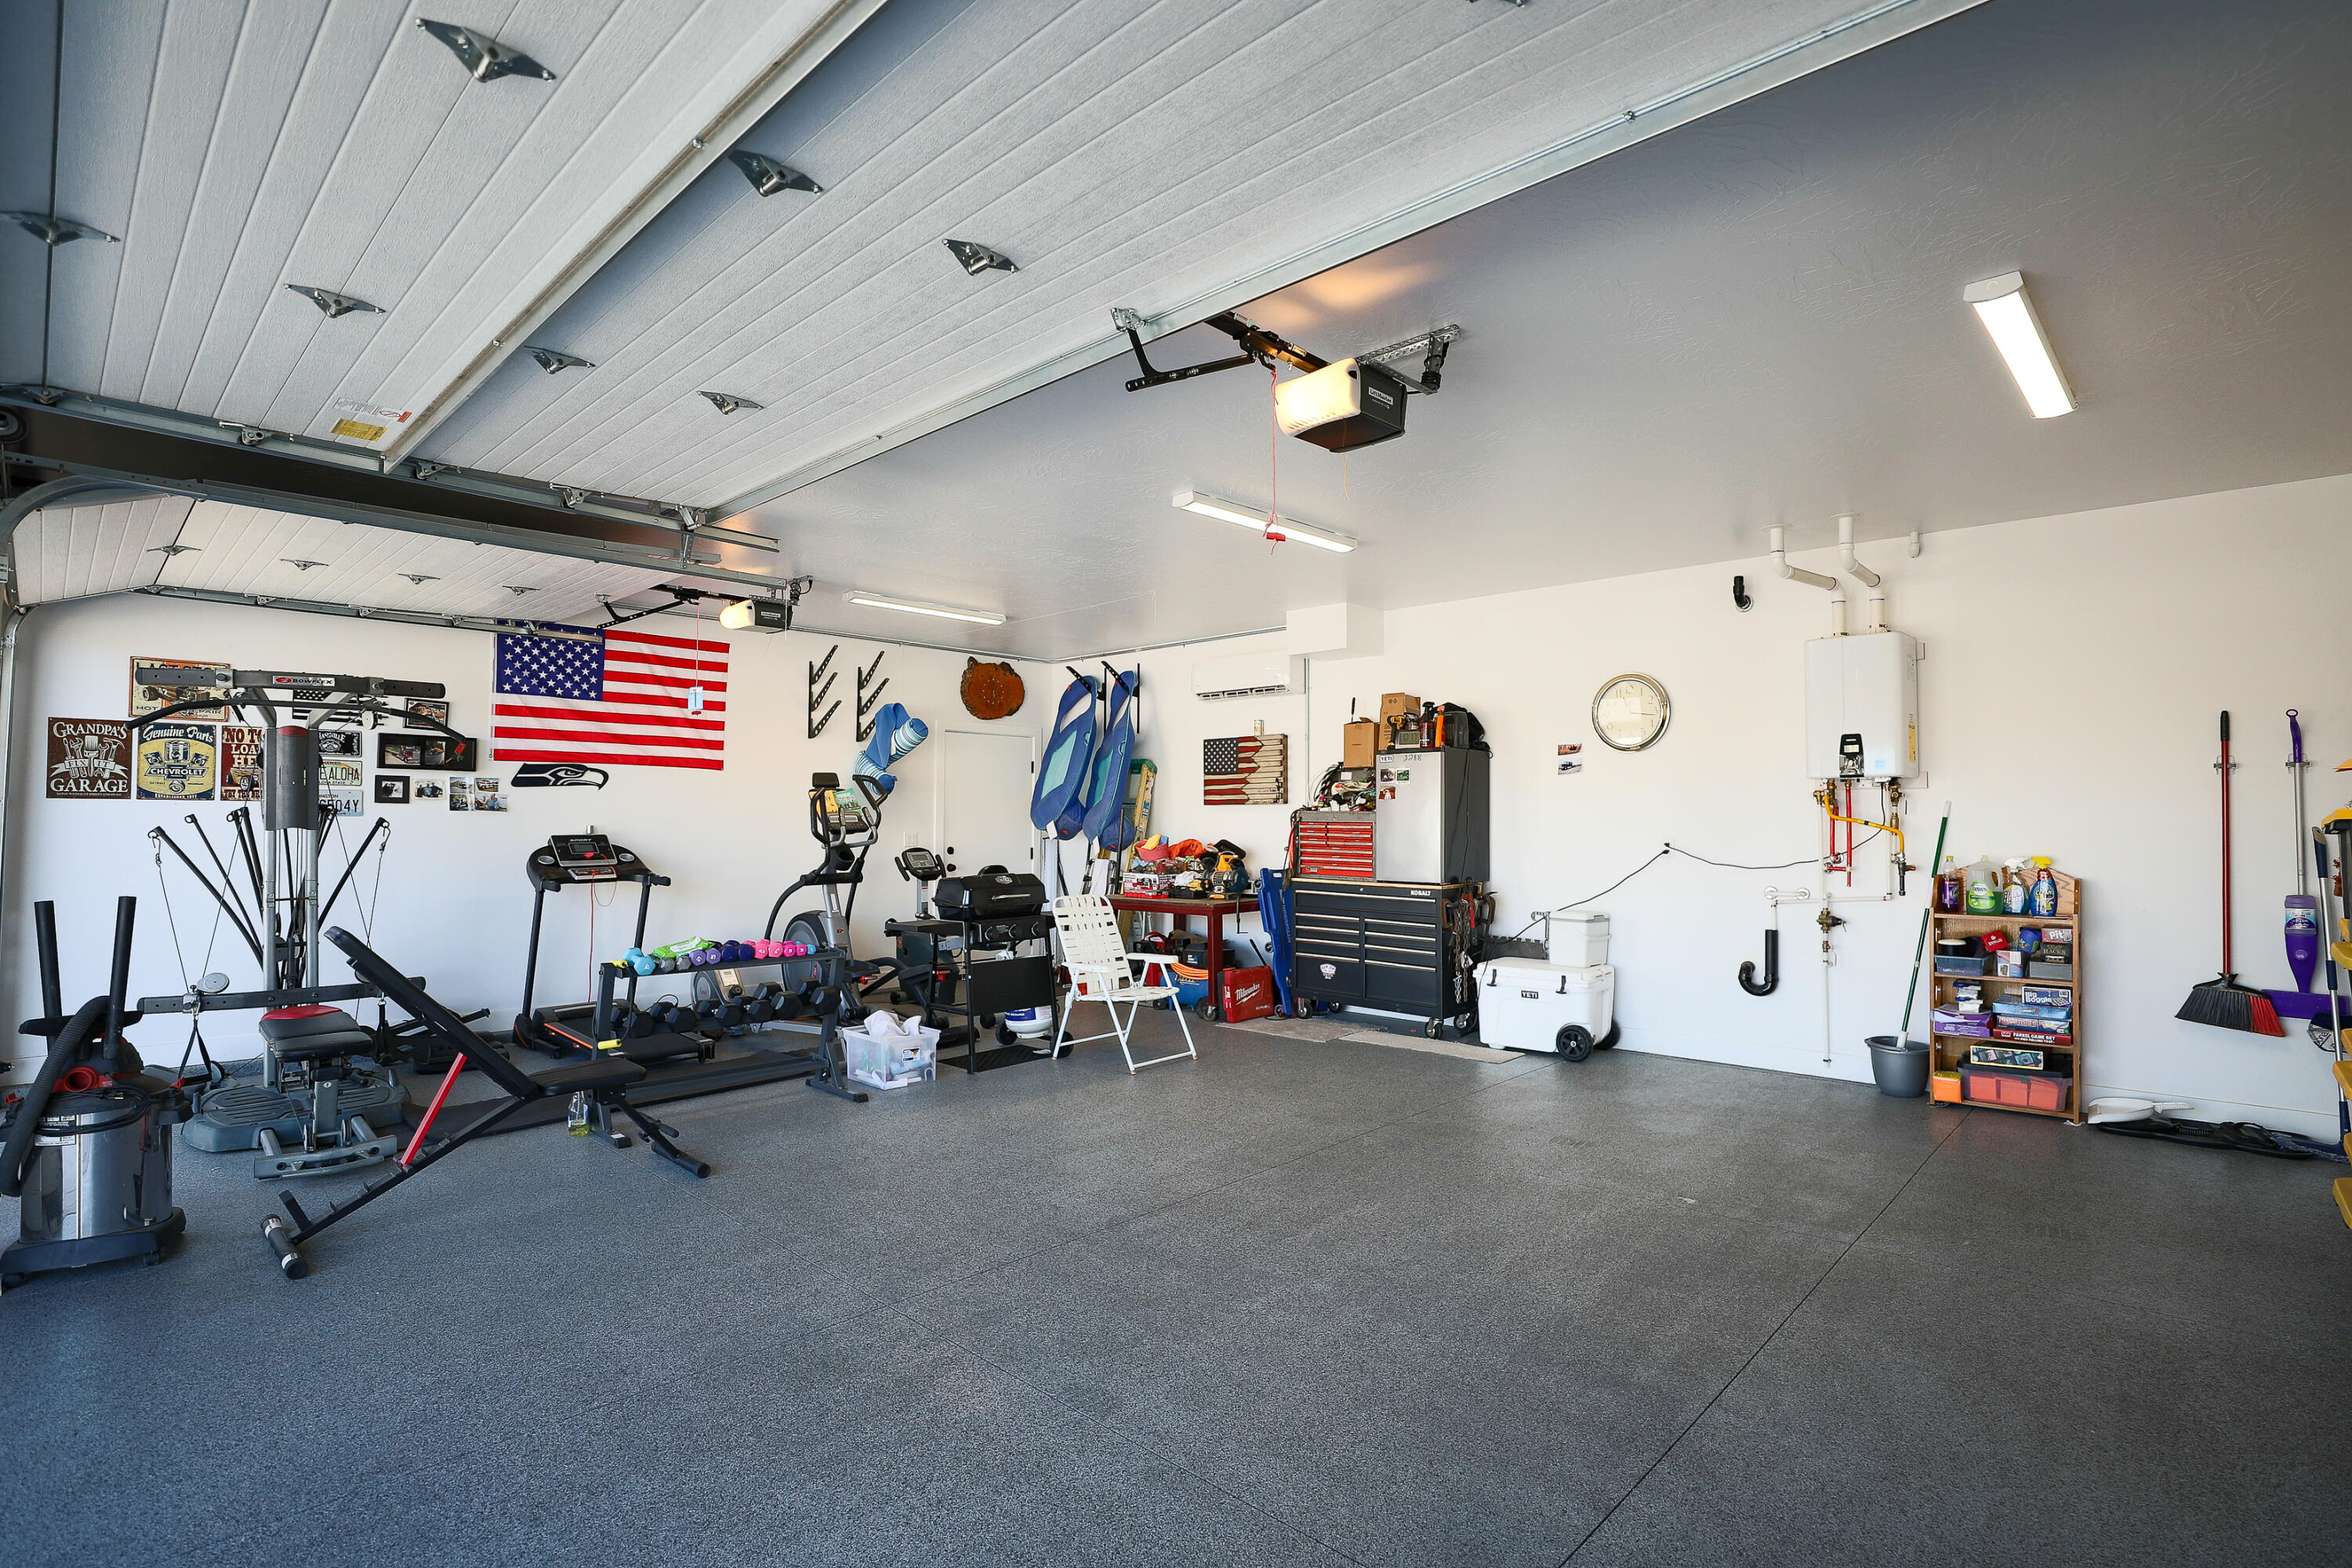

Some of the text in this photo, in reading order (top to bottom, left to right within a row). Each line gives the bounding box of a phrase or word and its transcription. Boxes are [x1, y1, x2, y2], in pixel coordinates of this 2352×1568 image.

[1370, 388, 1392, 403] LiftMaster
[53, 721, 127, 739] GRANDPA'S
[143, 724, 214, 743] Genuine Parts
[225, 728, 244, 743] NO
[150, 767, 204, 775] CHEVROLET
[328, 767, 360, 781] ALOHA
[49, 778, 129, 793] GARAGE
[2049, 929, 2063, 940] Pit
[1235, 982, 1261, 1001] Milwaukee
